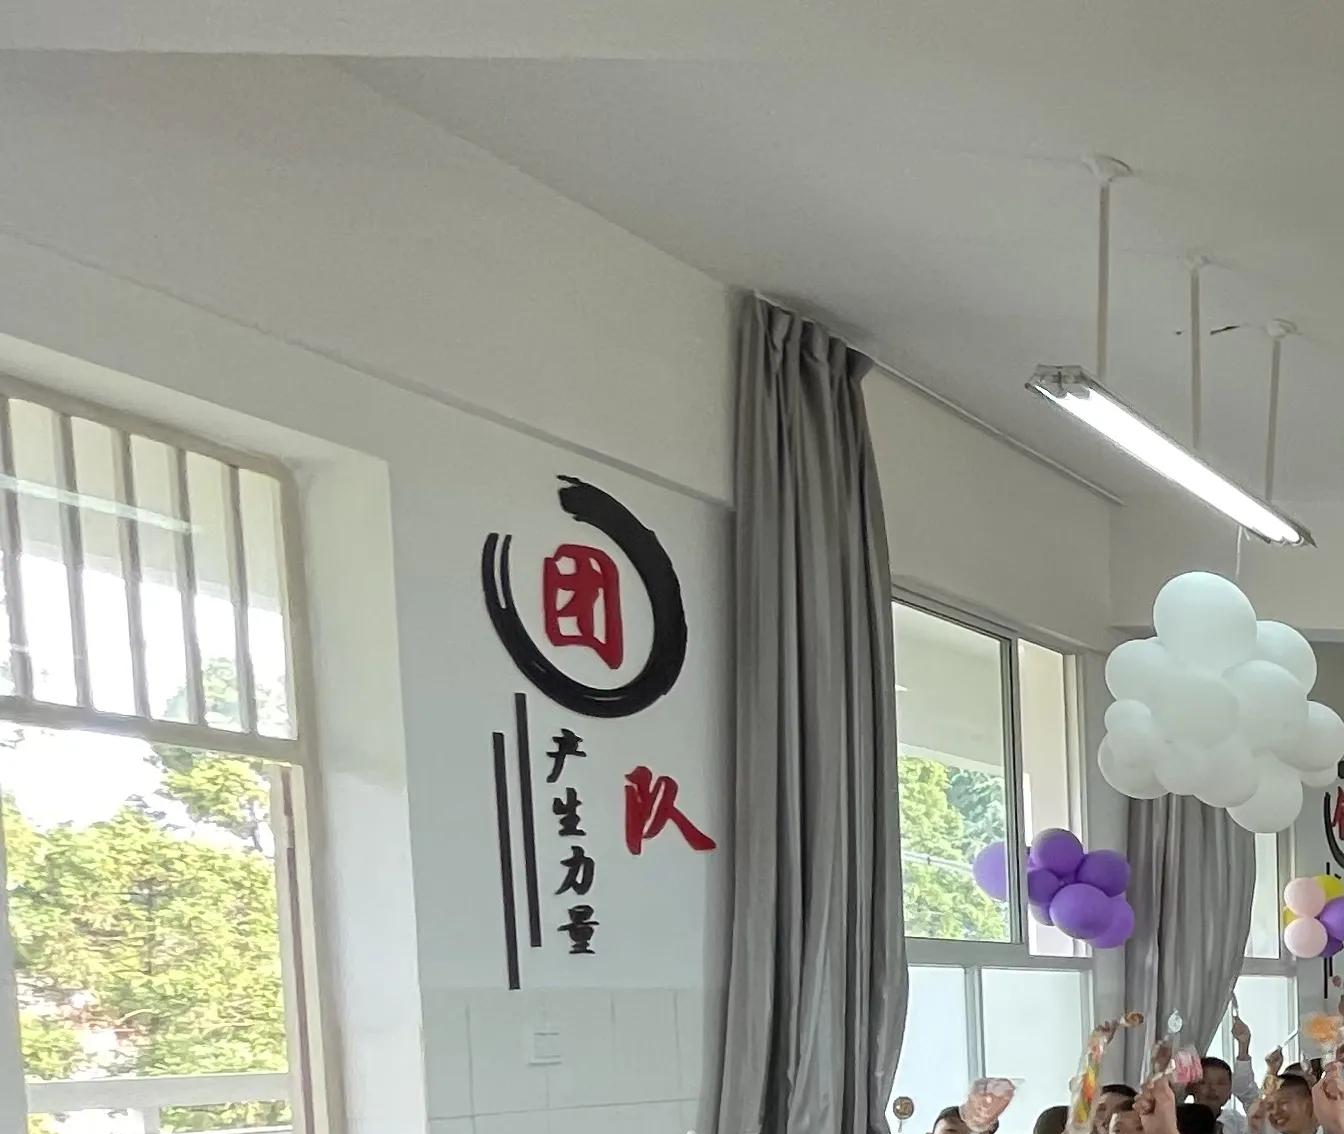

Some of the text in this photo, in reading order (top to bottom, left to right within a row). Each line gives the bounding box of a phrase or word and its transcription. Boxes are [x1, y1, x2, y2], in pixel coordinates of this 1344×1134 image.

[543, 543, 625, 670] 团
[545, 727, 600, 955] 产生力量
[624, 765, 717, 855] 队
